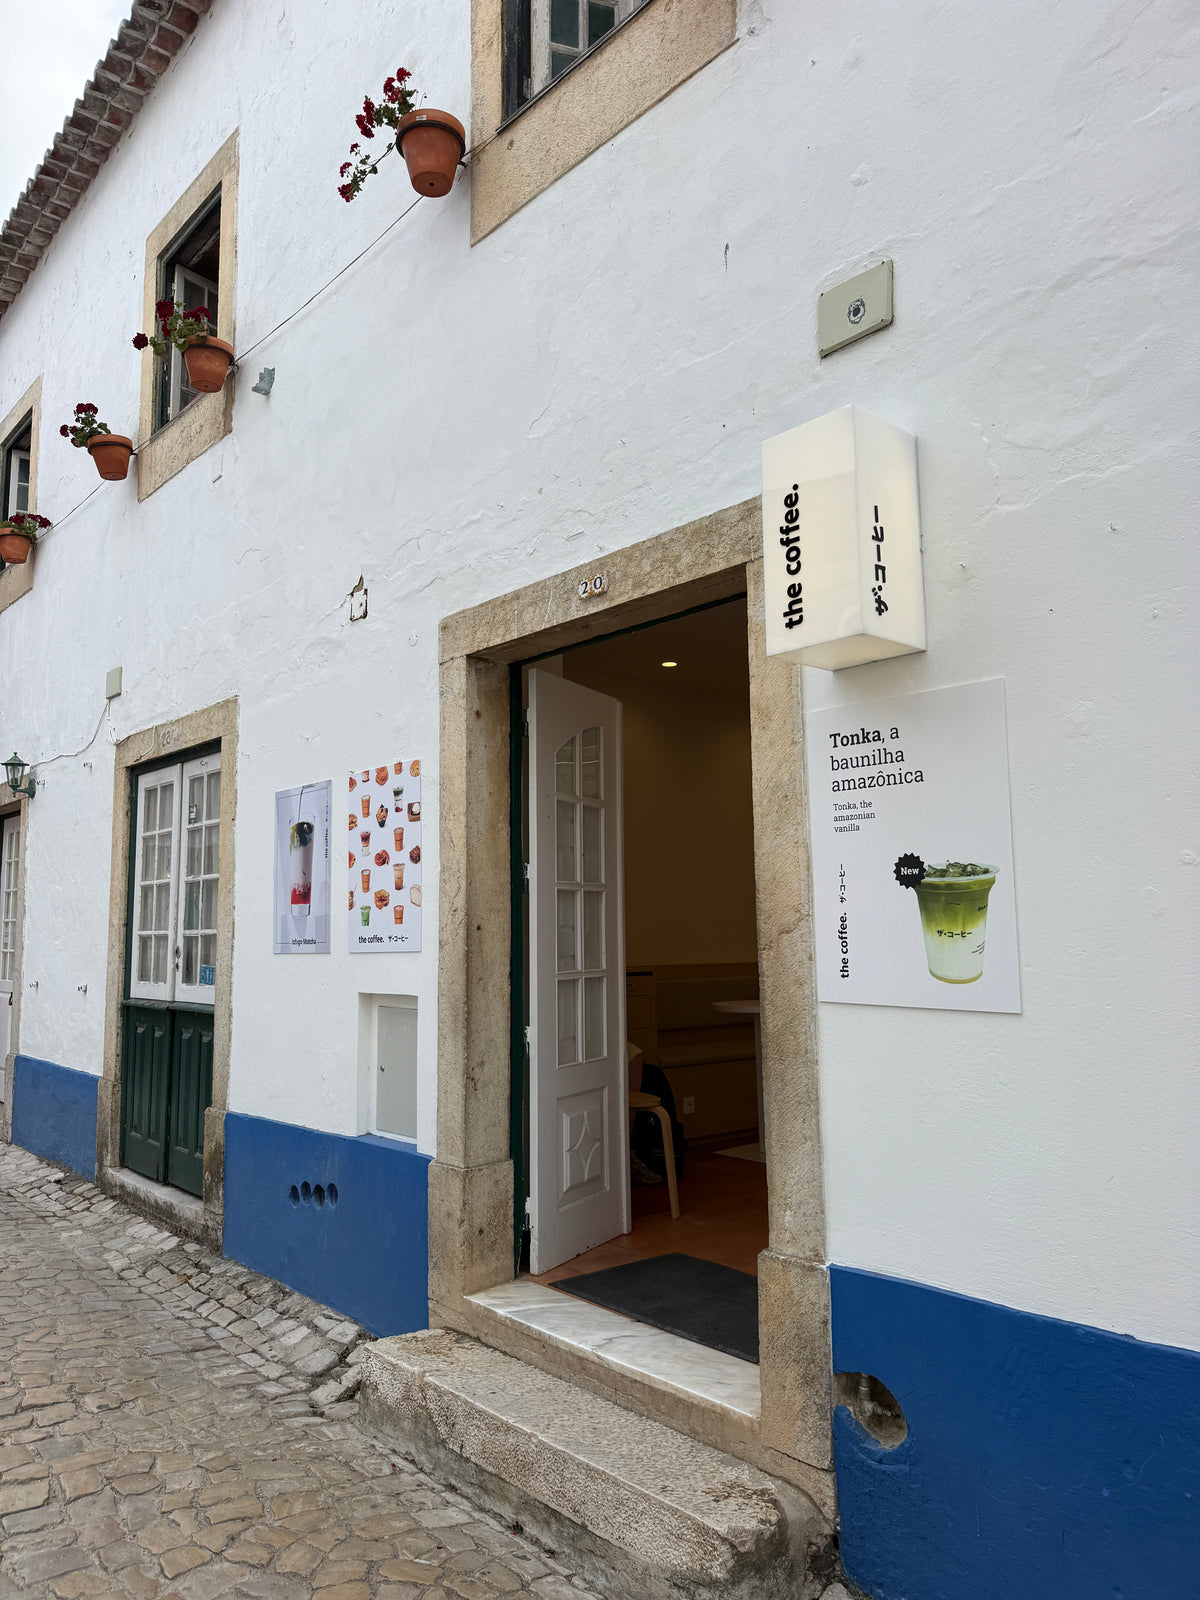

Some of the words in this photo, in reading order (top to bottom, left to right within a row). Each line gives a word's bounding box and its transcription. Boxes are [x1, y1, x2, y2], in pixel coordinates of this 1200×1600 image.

[780, 483, 801, 576] coffee.
[581, 576, 602, 595] 20
[783, 582, 804, 629] the
[829, 728, 885, 748] Tonka,
[890, 727, 899, 740] a
[830, 748, 905, 771] baunilha
[832, 768, 924, 792] amazônica
[833, 802, 859, 811] Tonka,
[860, 800, 873, 809] the
[833, 811, 876, 822] amazonian
[834, 823, 860, 833] vanilla
[900, 867, 919, 876] New
[358, 935, 367, 944] the
[368, 934, 385, 944] coffee.
[838, 912, 849, 955] coffee.
[840, 957, 849, 979] the
